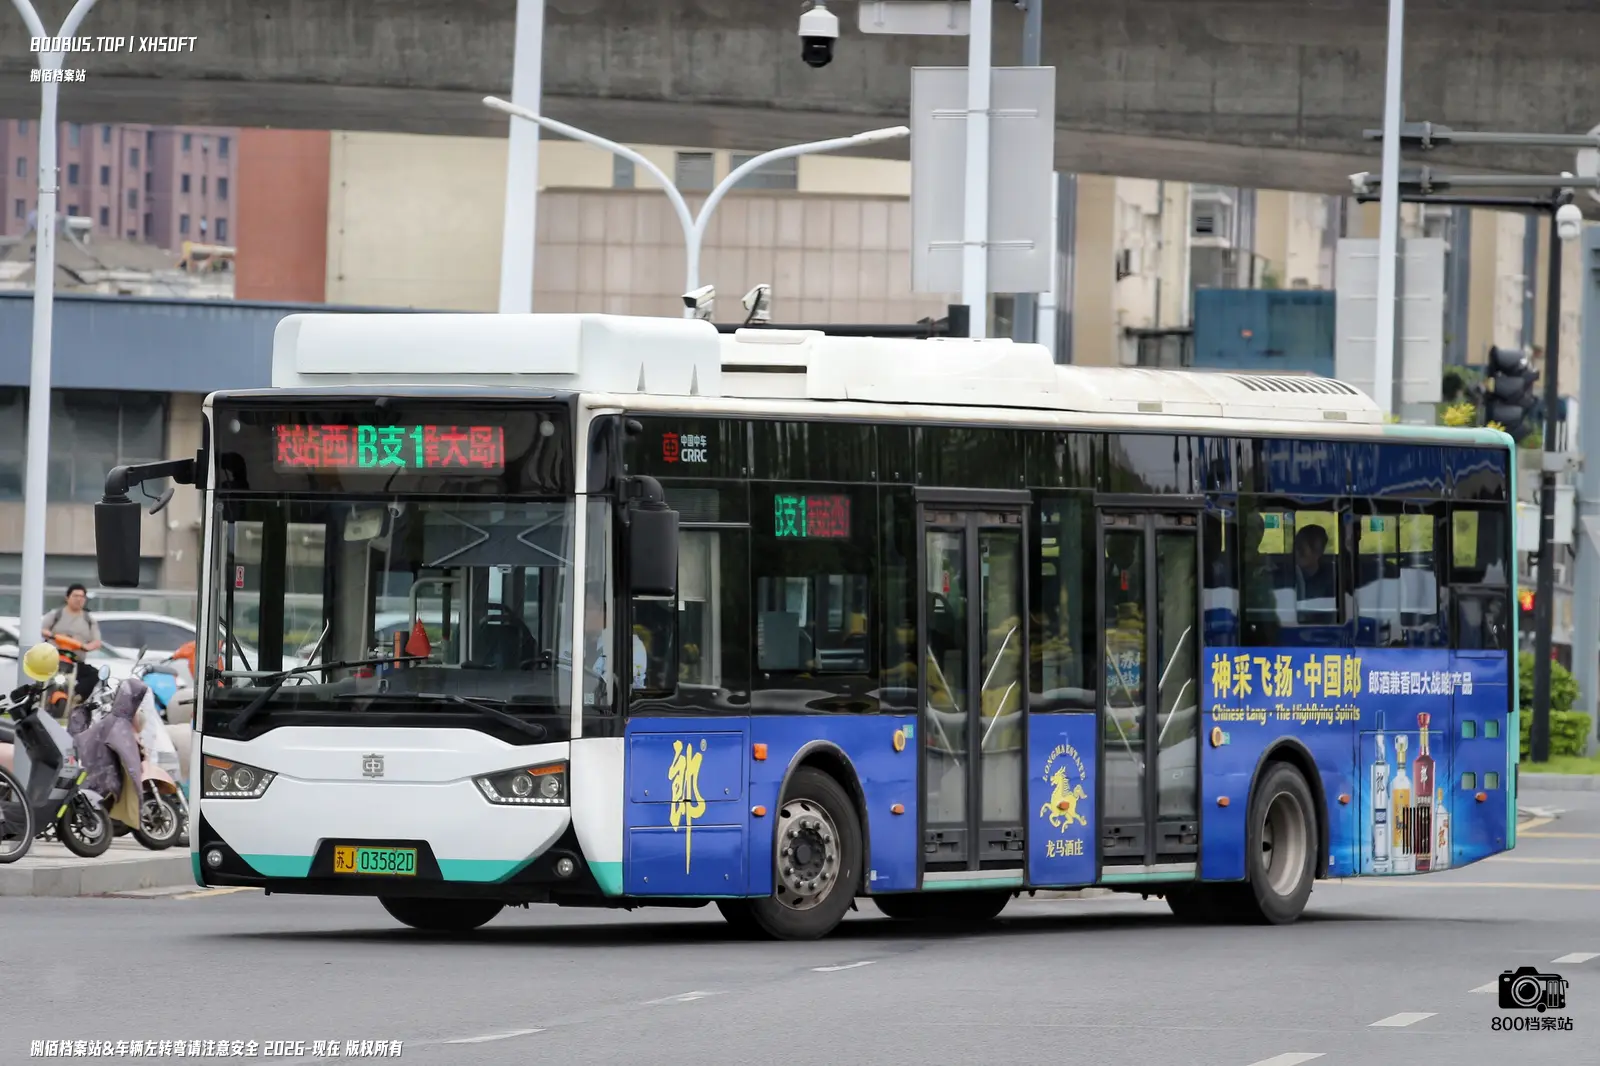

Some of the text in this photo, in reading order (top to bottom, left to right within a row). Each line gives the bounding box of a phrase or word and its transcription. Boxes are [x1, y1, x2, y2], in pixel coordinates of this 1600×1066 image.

[357, 424, 424, 469] B支1
[680, 434, 707, 447] 中国中车
[680, 448, 708, 463] CRRC
[1211, 653, 1362, 699] 神采飞扬·中国郎
[1368, 669, 1473, 696] 郎酒兼香四大战略产品
[1212, 703, 1245, 722] Chinese
[1246, 704, 1267, 726] Lang
[1275, 703, 1291, 721] The
[1292, 703, 1334, 726] Highflying
[1335, 704, 1361, 726] Spirits
[1045, 838, 1084, 858] 龙马酒庄
[360, 851, 414, 872] 03582D
